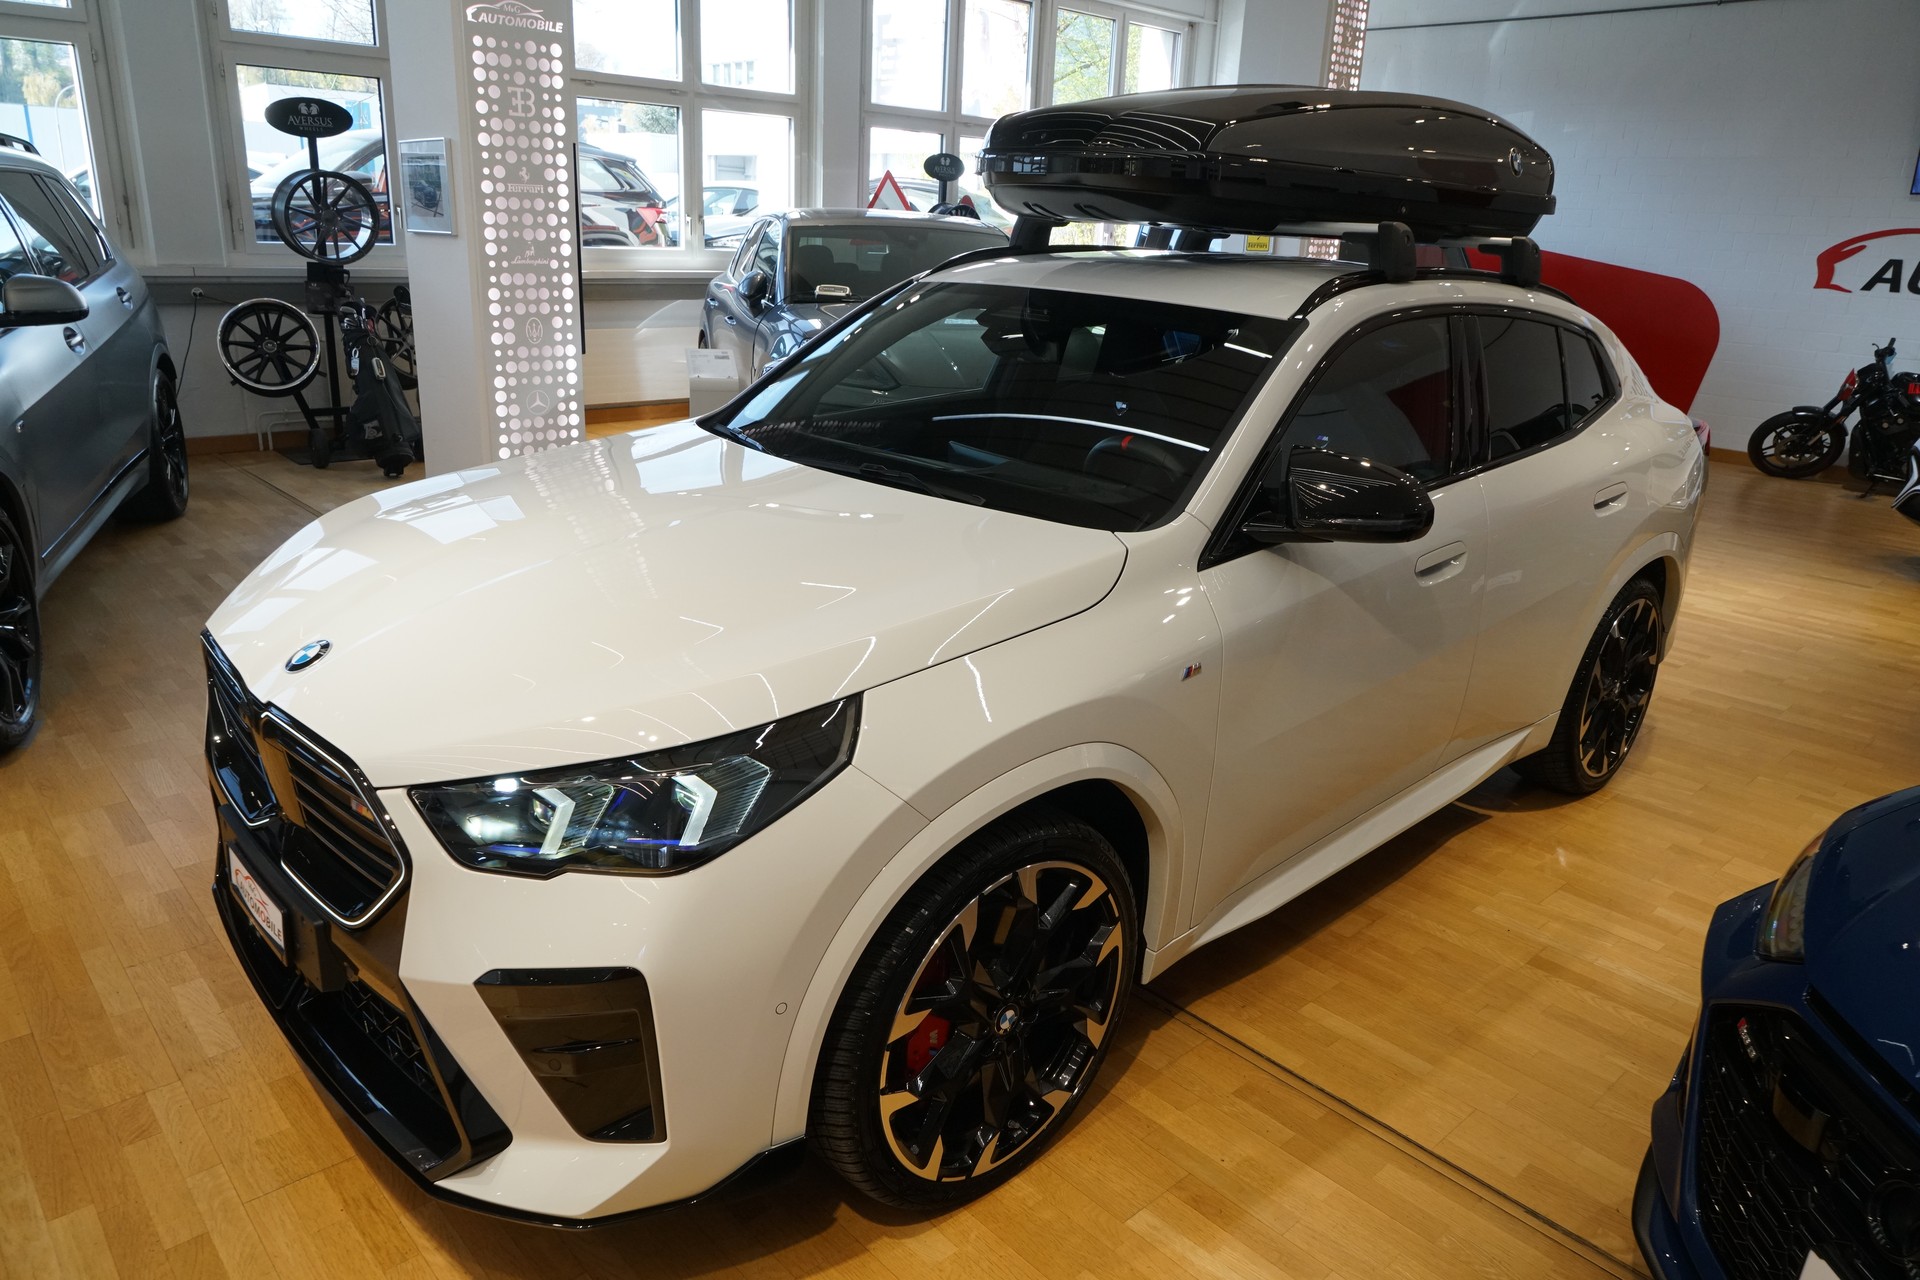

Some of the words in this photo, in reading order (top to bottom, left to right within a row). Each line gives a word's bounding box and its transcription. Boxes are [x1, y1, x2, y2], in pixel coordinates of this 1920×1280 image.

[478, 12, 564, 34] AUTOMOBILE
[288, 115, 333, 127] AVERSUS
[507, 183, 545, 194] Ferrari
[239, 880, 283, 942] AUTOMOBILE
